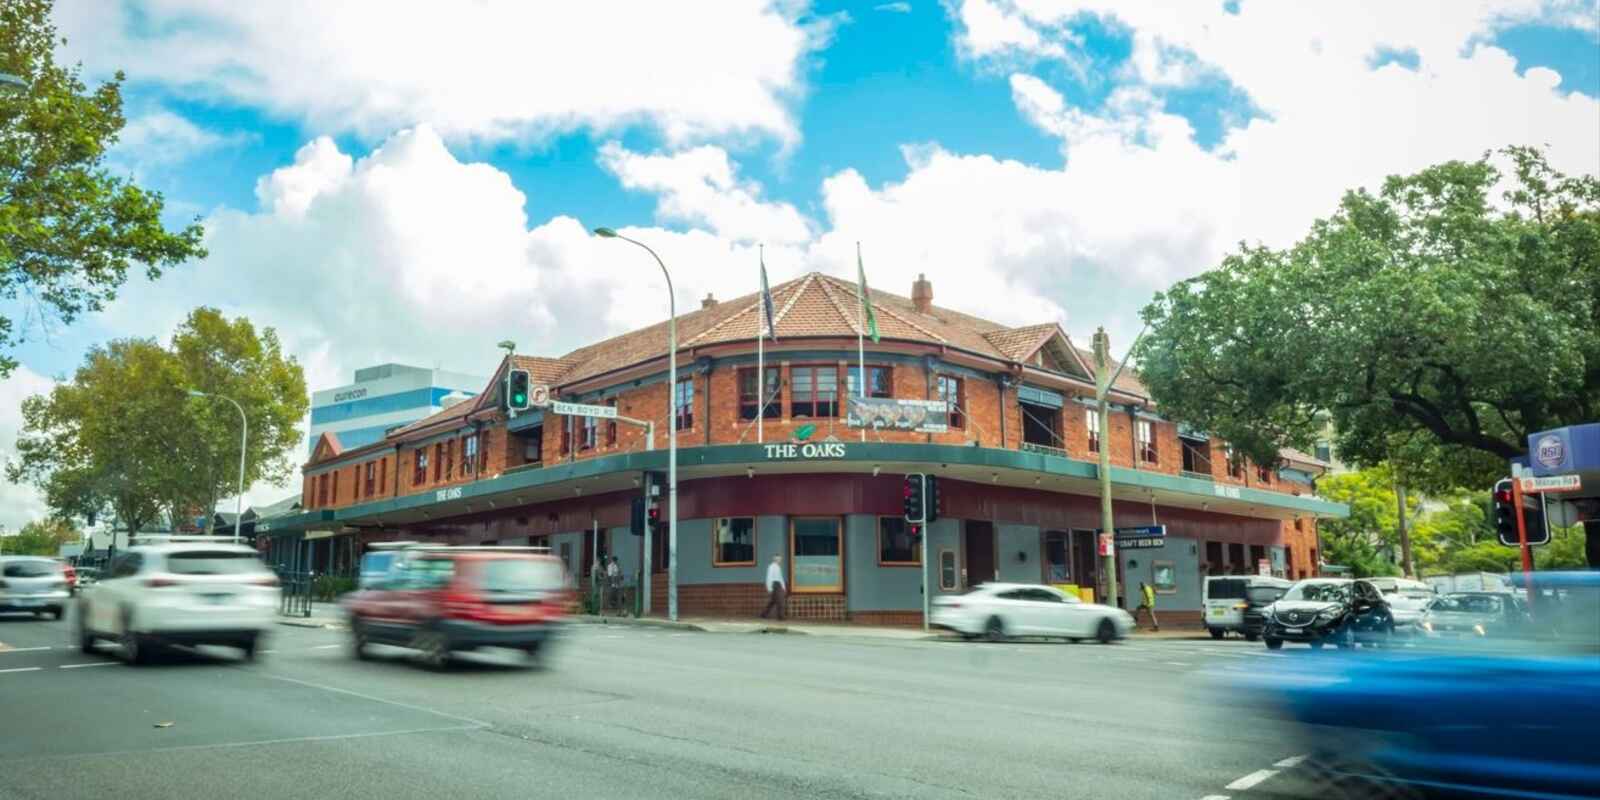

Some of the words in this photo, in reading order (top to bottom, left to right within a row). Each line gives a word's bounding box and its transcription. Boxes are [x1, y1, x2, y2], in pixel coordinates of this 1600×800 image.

[556, 404, 573, 413] BEN
[577, 405, 599, 415] BOYD
[764, 444, 797, 458] THE
[802, 443, 845, 457] OAKS
